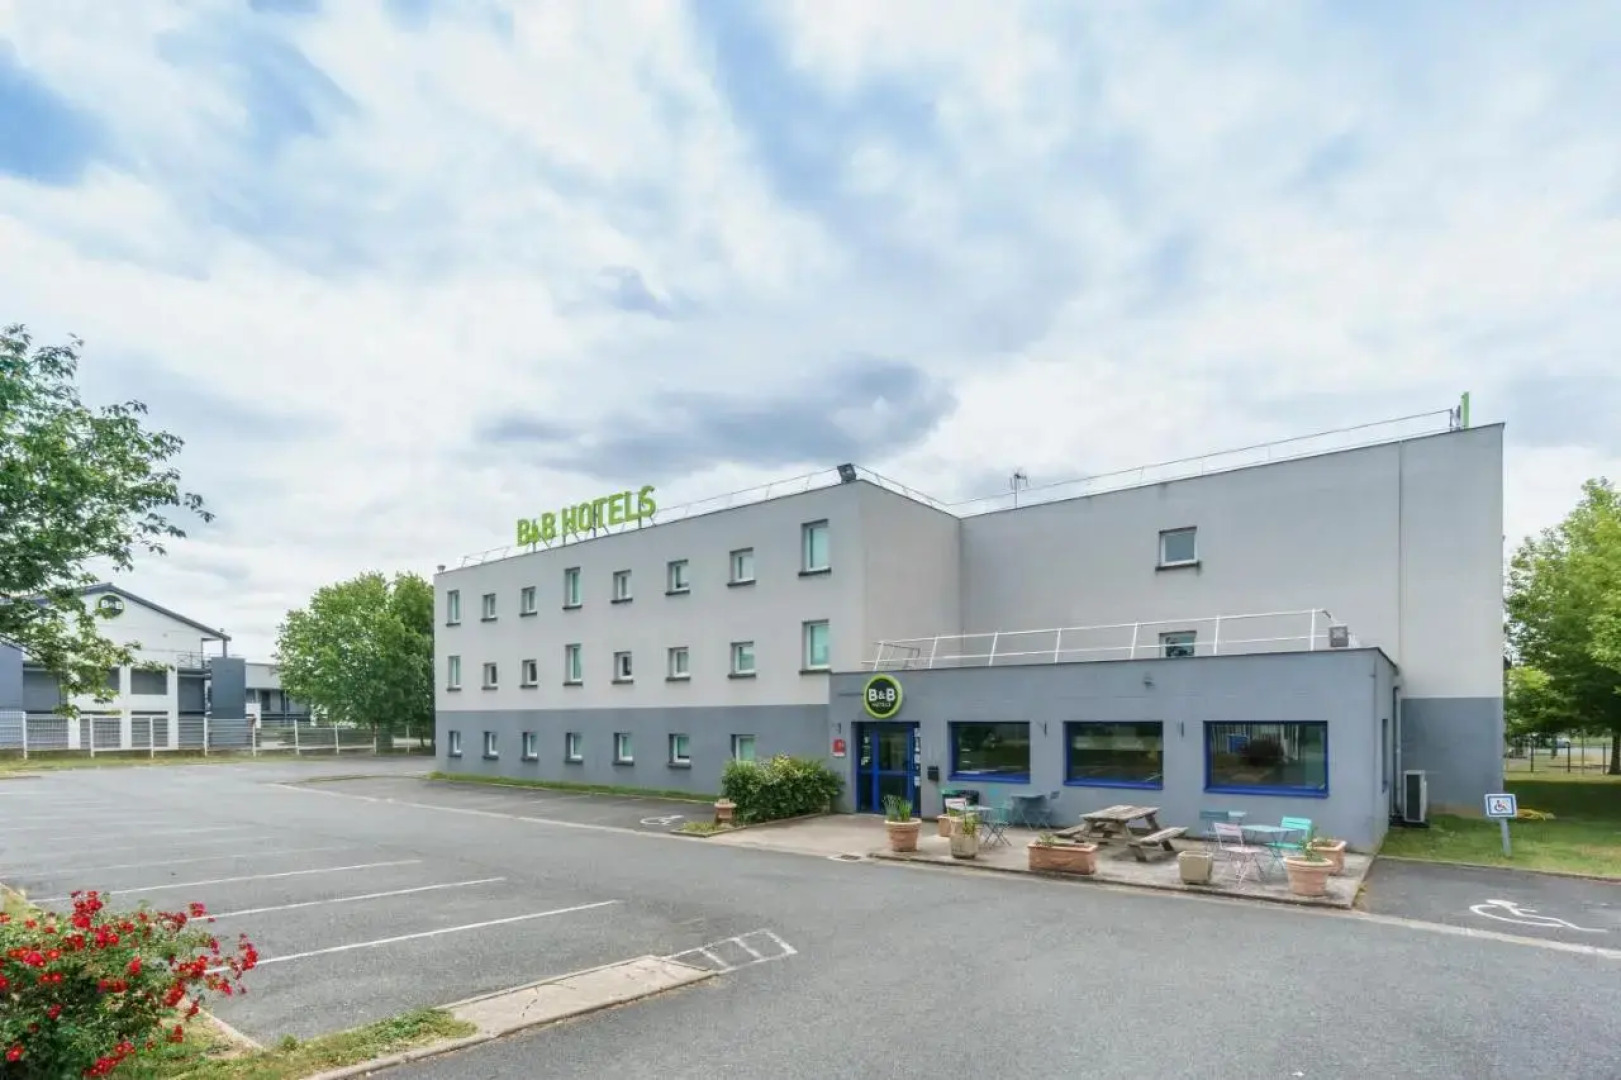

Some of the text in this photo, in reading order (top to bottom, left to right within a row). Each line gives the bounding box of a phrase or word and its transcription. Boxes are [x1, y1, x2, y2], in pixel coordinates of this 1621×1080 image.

[517, 485, 657, 547] B&B HOTELS
[868, 688, 896, 701] B&B
